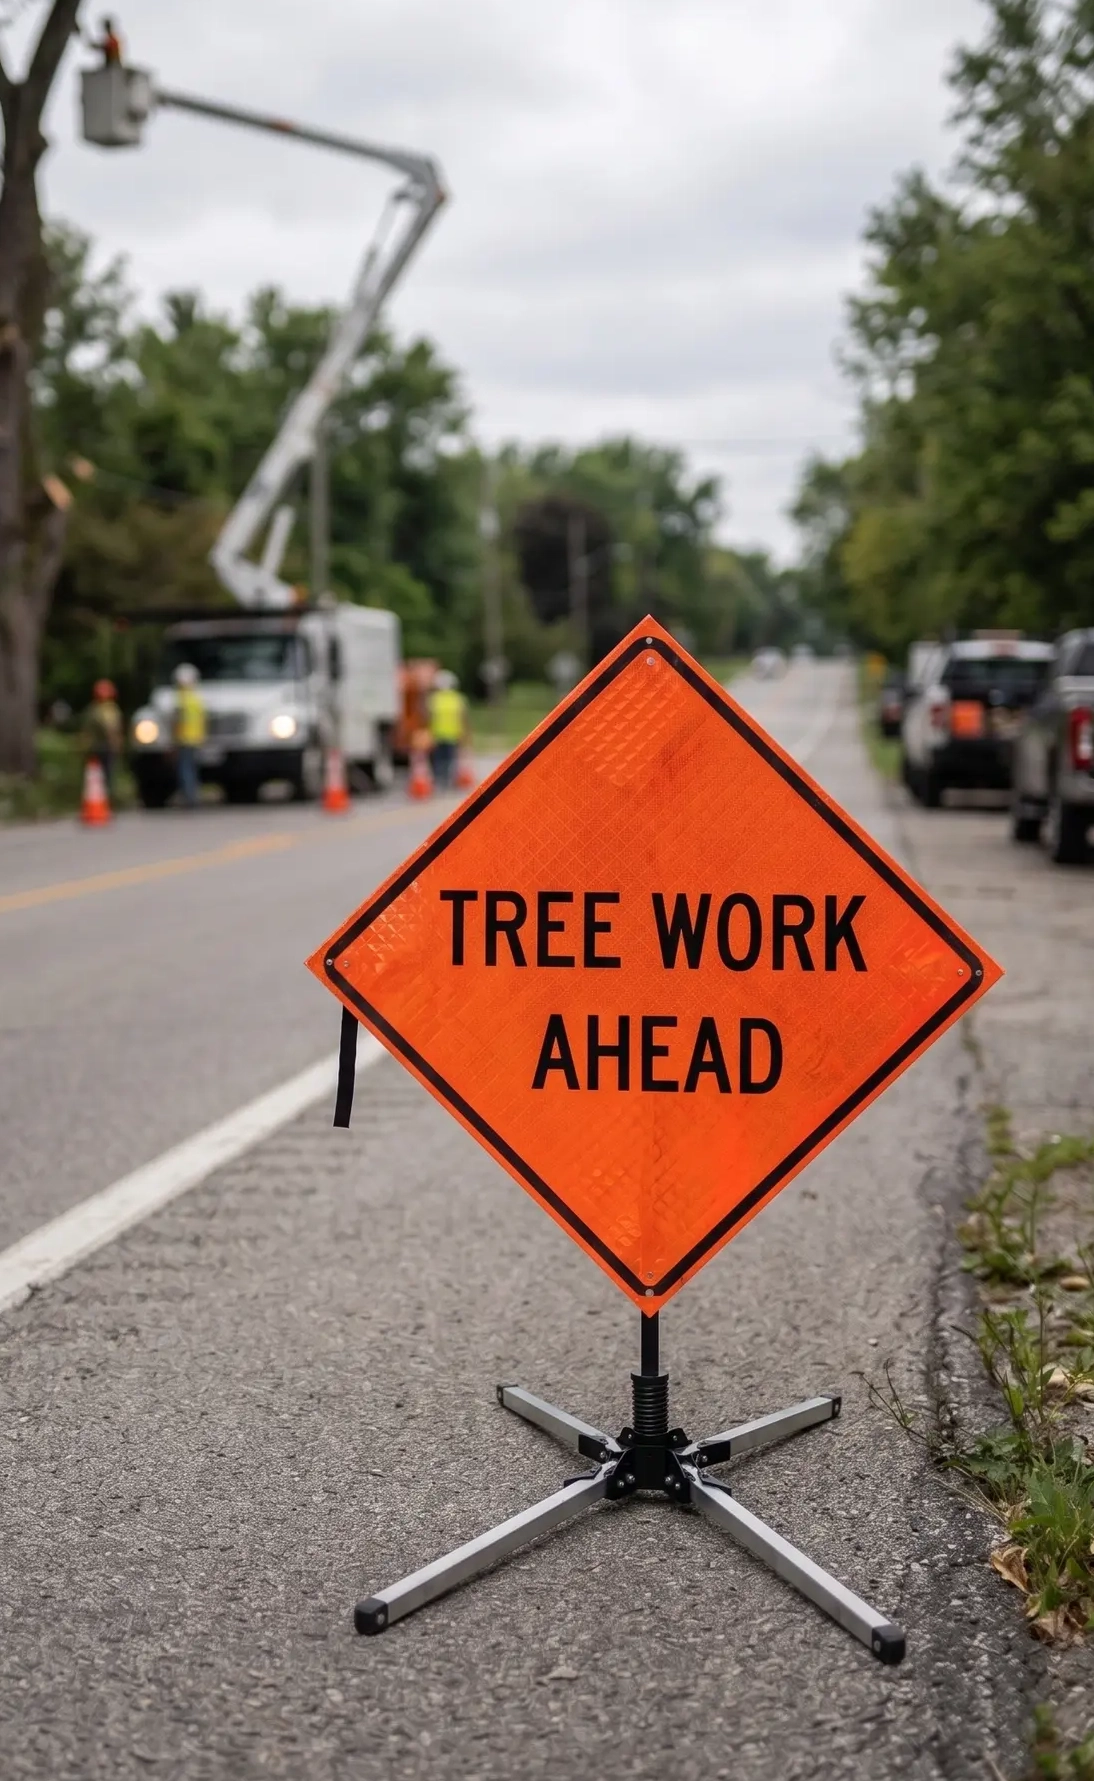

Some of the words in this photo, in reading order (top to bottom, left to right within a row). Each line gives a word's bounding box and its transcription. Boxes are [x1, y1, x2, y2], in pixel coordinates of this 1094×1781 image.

[440, 890, 621, 969] TREE
[651, 892, 867, 972] WORK
[531, 1013, 783, 1095] AHEAD
